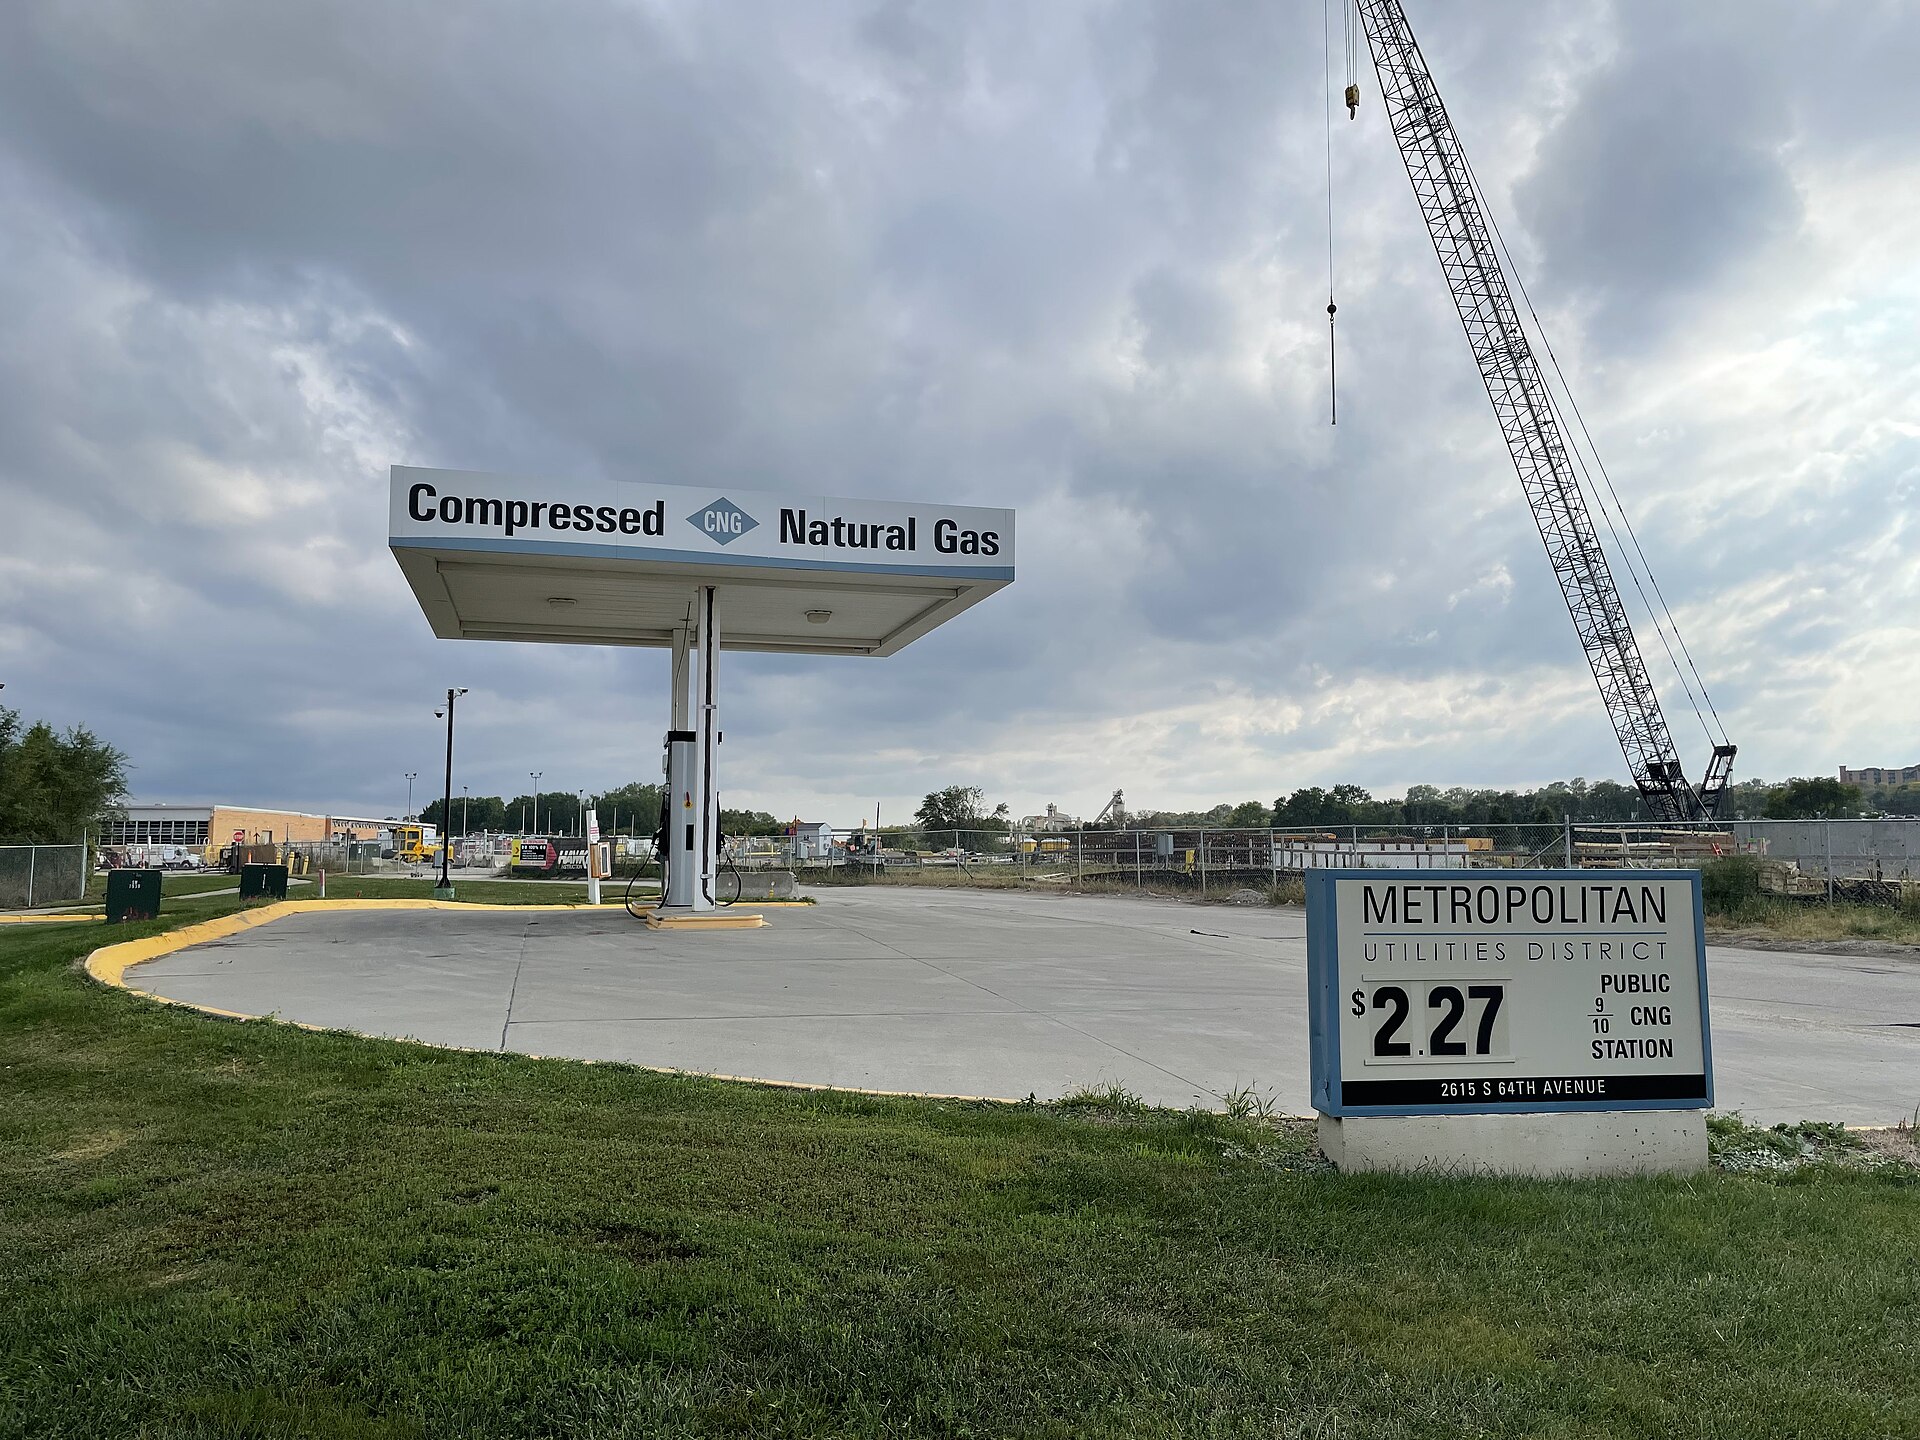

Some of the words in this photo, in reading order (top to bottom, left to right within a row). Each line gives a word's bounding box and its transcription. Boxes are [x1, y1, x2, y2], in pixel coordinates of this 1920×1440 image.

[408, 483, 665, 536] Compressed
[704, 510, 742, 534] CNG
[780, 508, 916, 551] Natural
[933, 519, 1000, 556] Gas
[1363, 886, 1667, 924] METROPOLITAN
[1364, 942, 1506, 961] UTILITIES
[1528, 942, 1667, 960] DISTRICT
[1601, 974, 1670, 993] PUBLIC
[1630, 1006, 1672, 1026] CNG
[1591, 1039, 1674, 1060] STATION
[1441, 1083, 1476, 1097] 2615
[1483, 1082, 1492, 1096] S
[1498, 1081, 1536, 1096] 64TH
[1543, 1080, 1606, 1095] AVENUE
